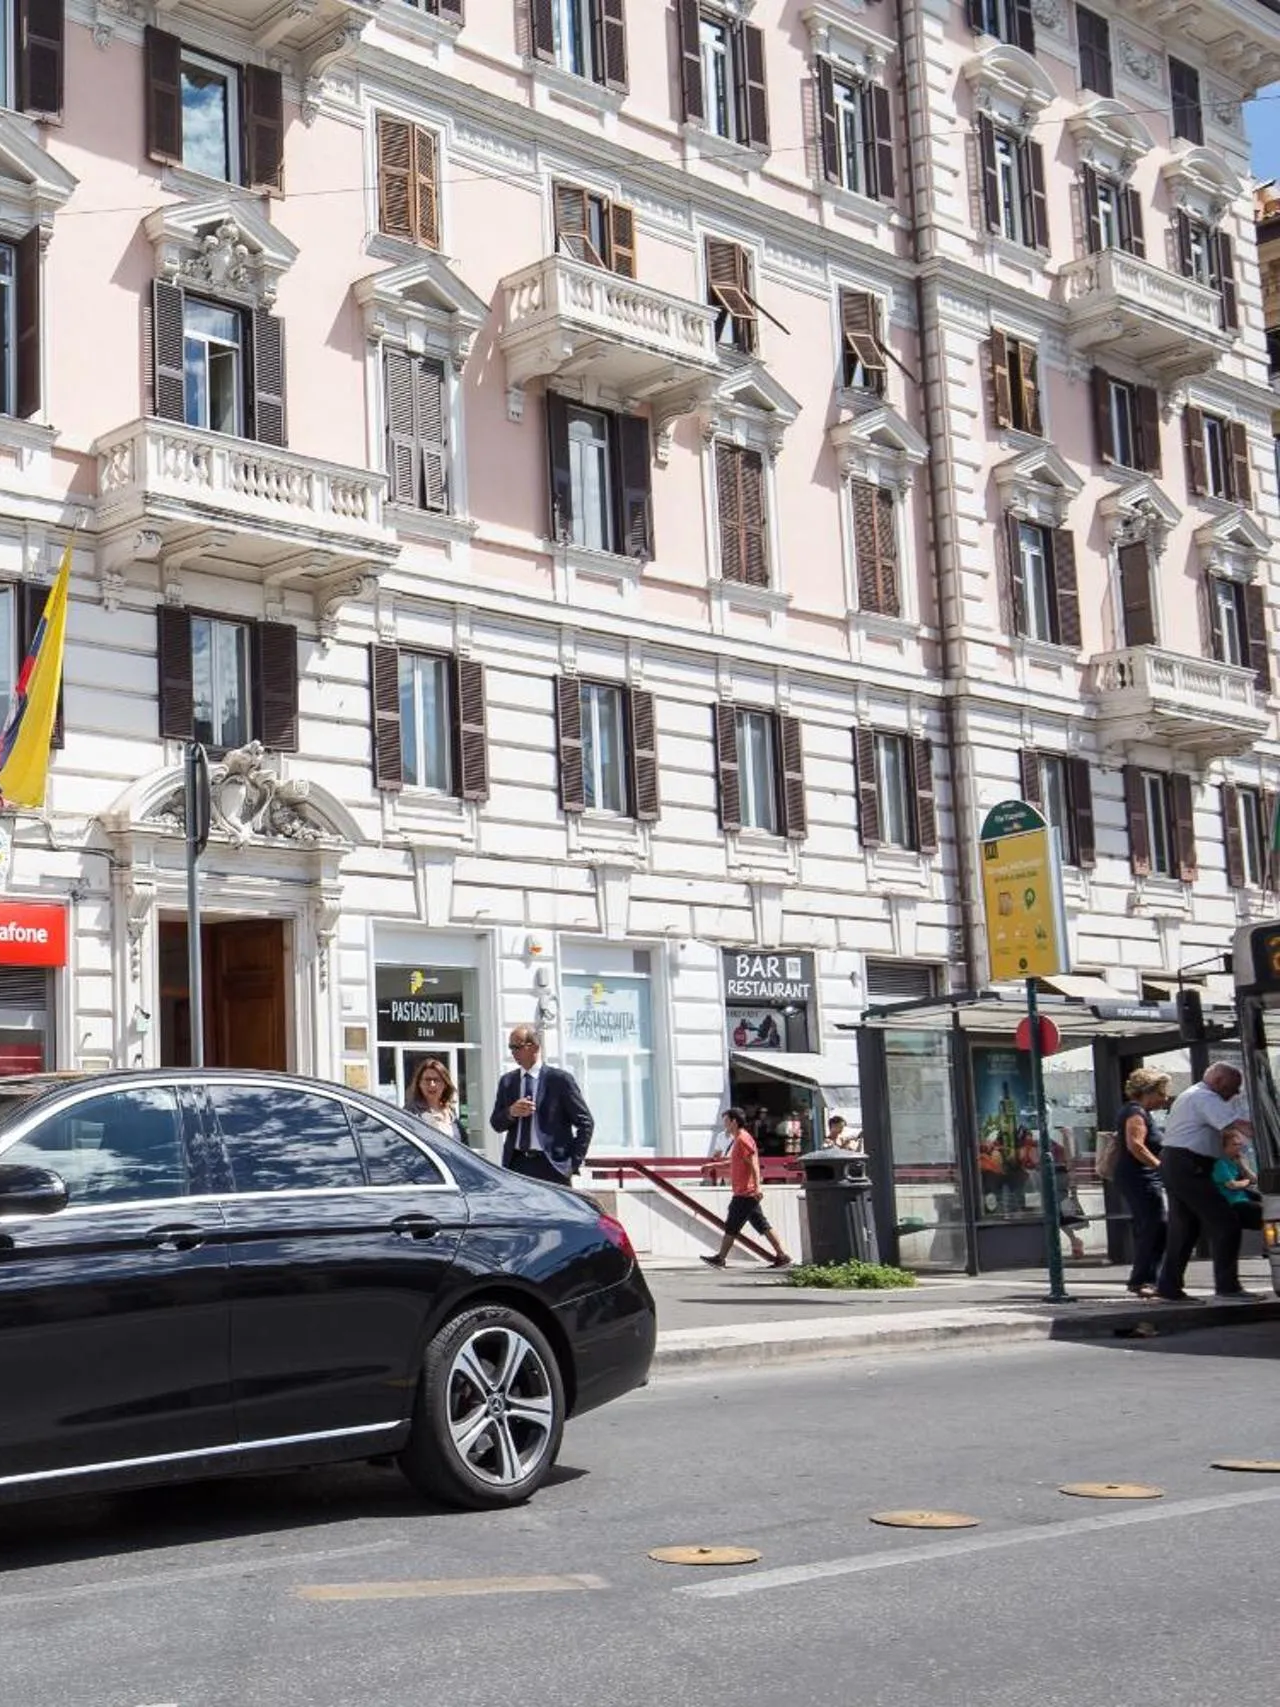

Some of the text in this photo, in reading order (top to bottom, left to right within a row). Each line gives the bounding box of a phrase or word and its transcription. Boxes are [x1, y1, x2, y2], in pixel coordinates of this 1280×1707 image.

[736, 954, 780, 978] BAR
[728, 980, 811, 998] RESTAURANT
[391, 1001, 460, 1023] PASTASCIUTTA
